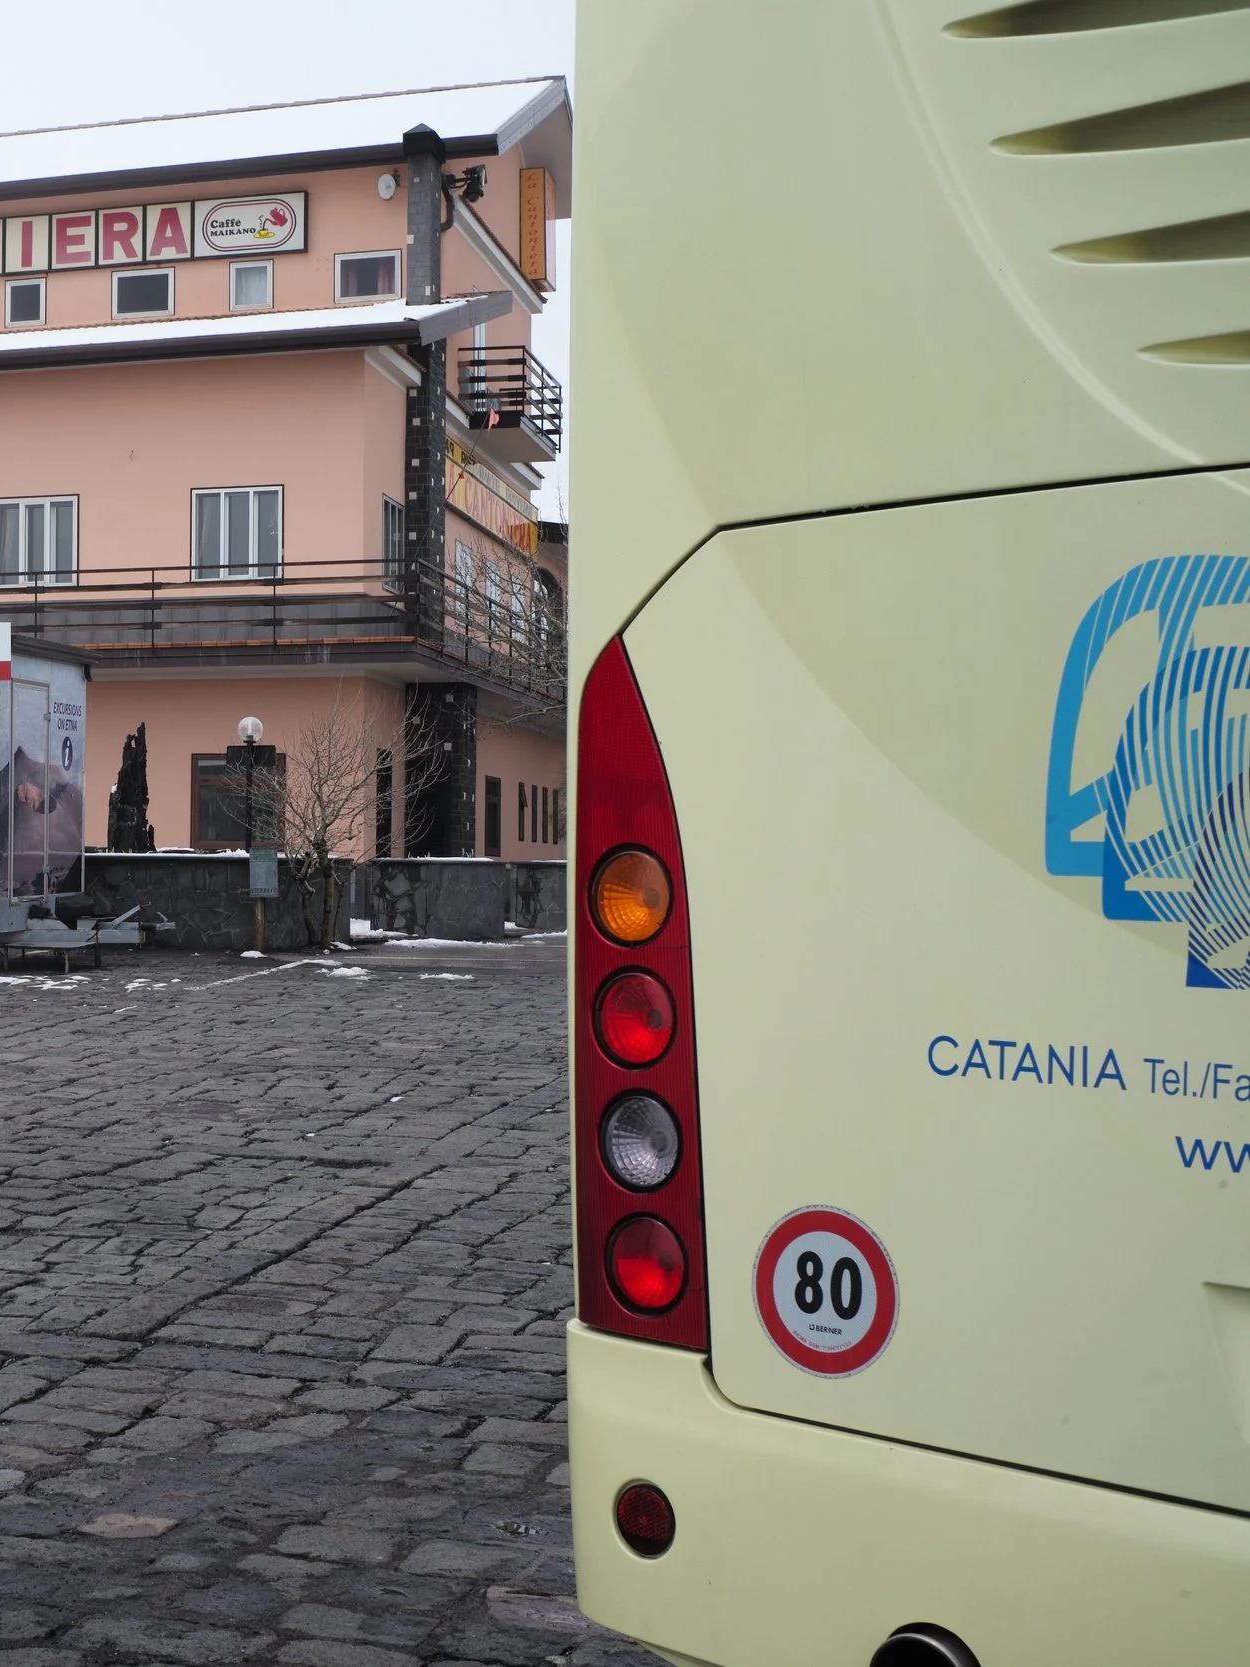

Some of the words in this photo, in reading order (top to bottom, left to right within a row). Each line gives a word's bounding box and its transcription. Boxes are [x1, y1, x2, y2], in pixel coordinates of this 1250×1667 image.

[210, 227, 256, 237] MAIKANO
[53, 701, 82, 717] EXCURSIONS
[57, 718, 66, 731] ON
[66, 719, 78, 732] ETNA
[927, 1035, 1127, 1091] CATANIA
[794, 1250, 863, 1321] 80
[815, 1324, 843, 1335] BERNER
